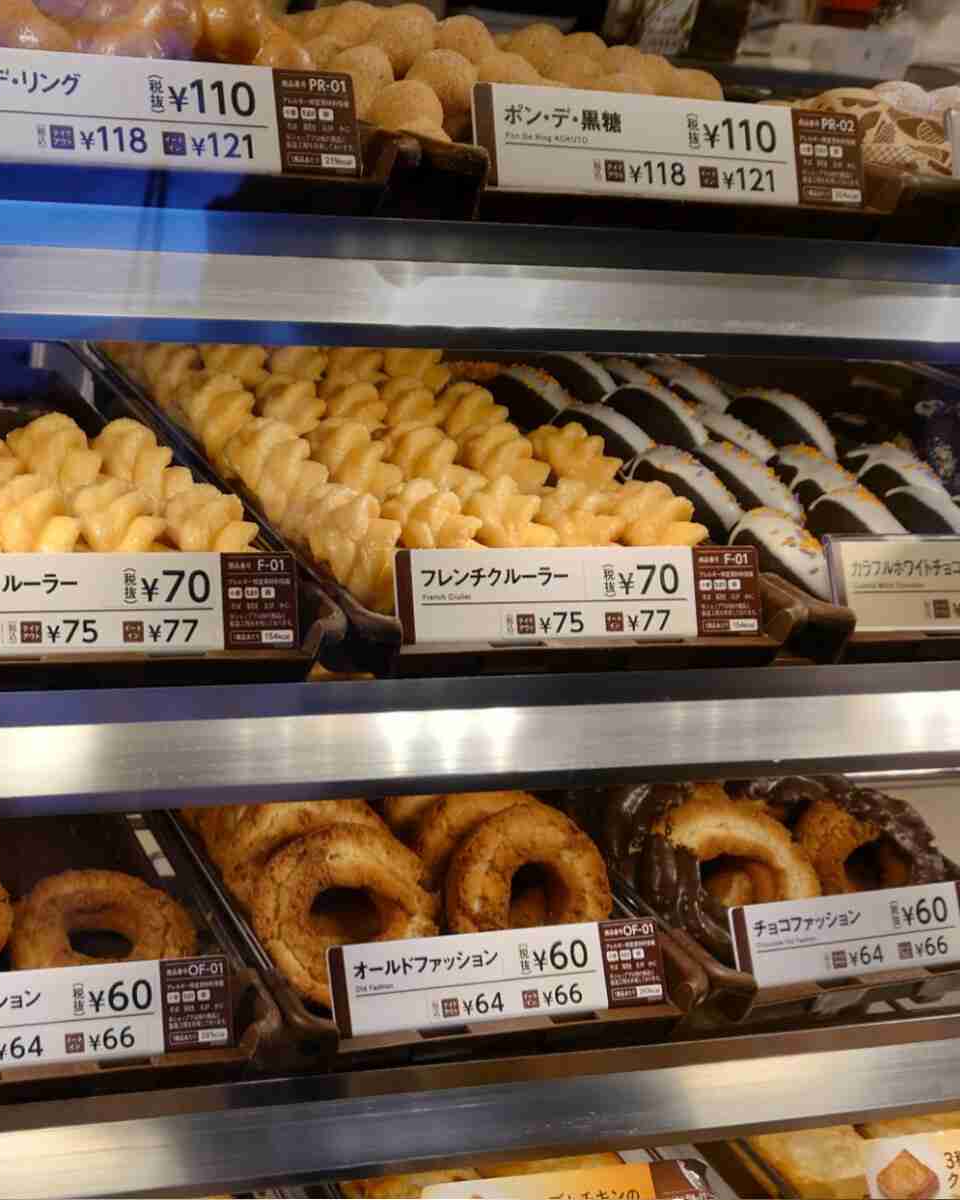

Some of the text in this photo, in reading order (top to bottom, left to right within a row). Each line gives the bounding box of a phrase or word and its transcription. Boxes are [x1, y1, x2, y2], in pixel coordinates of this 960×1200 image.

[169, 80, 256, 117] ¥110
[308, 79, 347, 98] PR-01
[504, 104, 623, 134] ポン・デ・黒糖
[80, 126, 148, 154] ¥118
[192, 133, 255, 159] ¥121
[703, 118, 777, 154] ¥110
[628, 161, 775, 193] ¥118 ¥121
[257, 559, 285, 572] F-01
[421, 567, 569, 588] フレンチクルーラー
[724, 557, 748, 570] F-01
[141, 569, 211, 604] ¥70
[619, 564, 680, 595] ¥70
[46, 618, 199, 644] ¥75 ¥77
[540, 609, 670, 634] ¥75 ¥77
[753, 911, 862, 938] チョコファッション
[902, 896, 948, 926] ¥60
[623, 923, 655, 938] OF-01
[353, 949, 499, 980] オールドファッション
[532, 938, 589, 972] ¥60
[848, 935, 949, 966] ¥64 ¥66
[188, 962, 225, 980] OF-01
[88, 978, 153, 1013] ¥60
[462, 982, 584, 1017] ¥64 ¥66
[89, 1025, 136, 1051] ¥66
